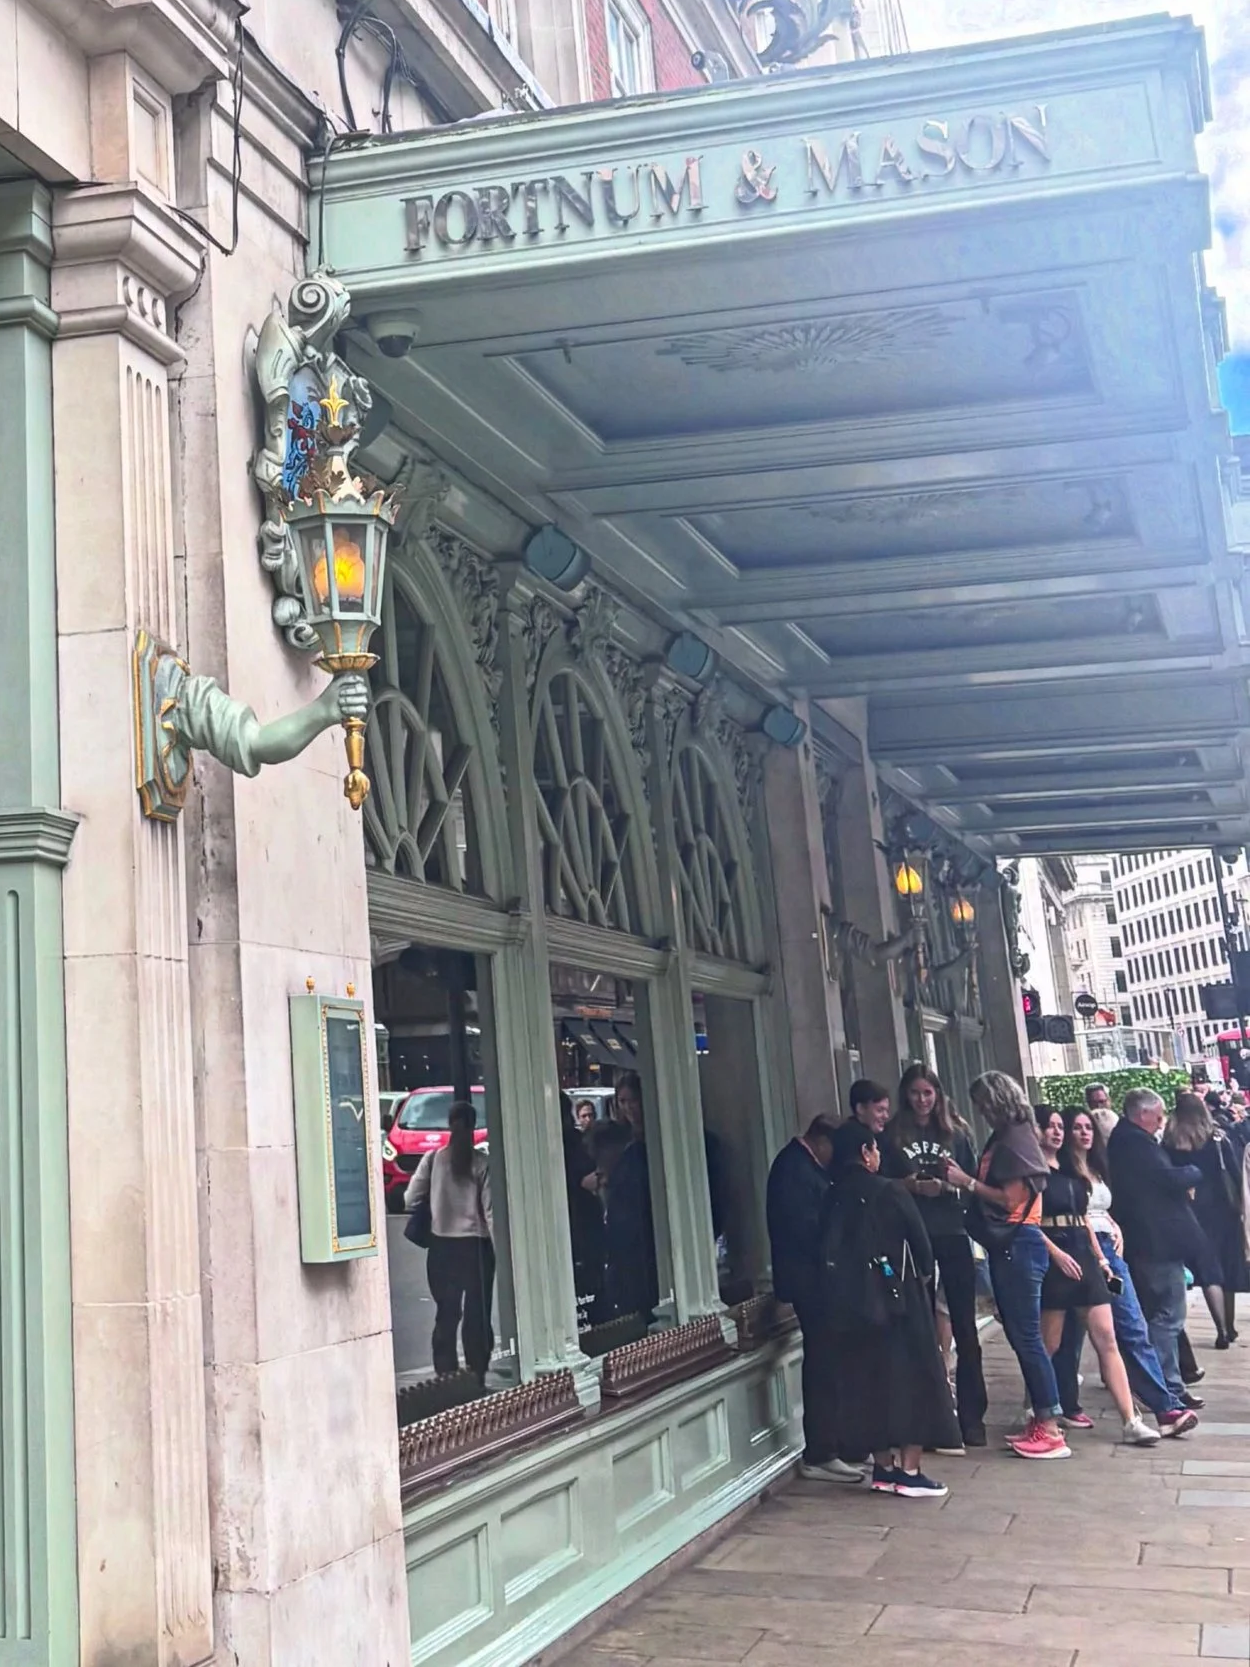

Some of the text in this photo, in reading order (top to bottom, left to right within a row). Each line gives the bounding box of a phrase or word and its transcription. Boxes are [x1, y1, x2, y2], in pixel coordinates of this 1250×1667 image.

[399, 102, 1052, 253] FORTNUM & MASON
